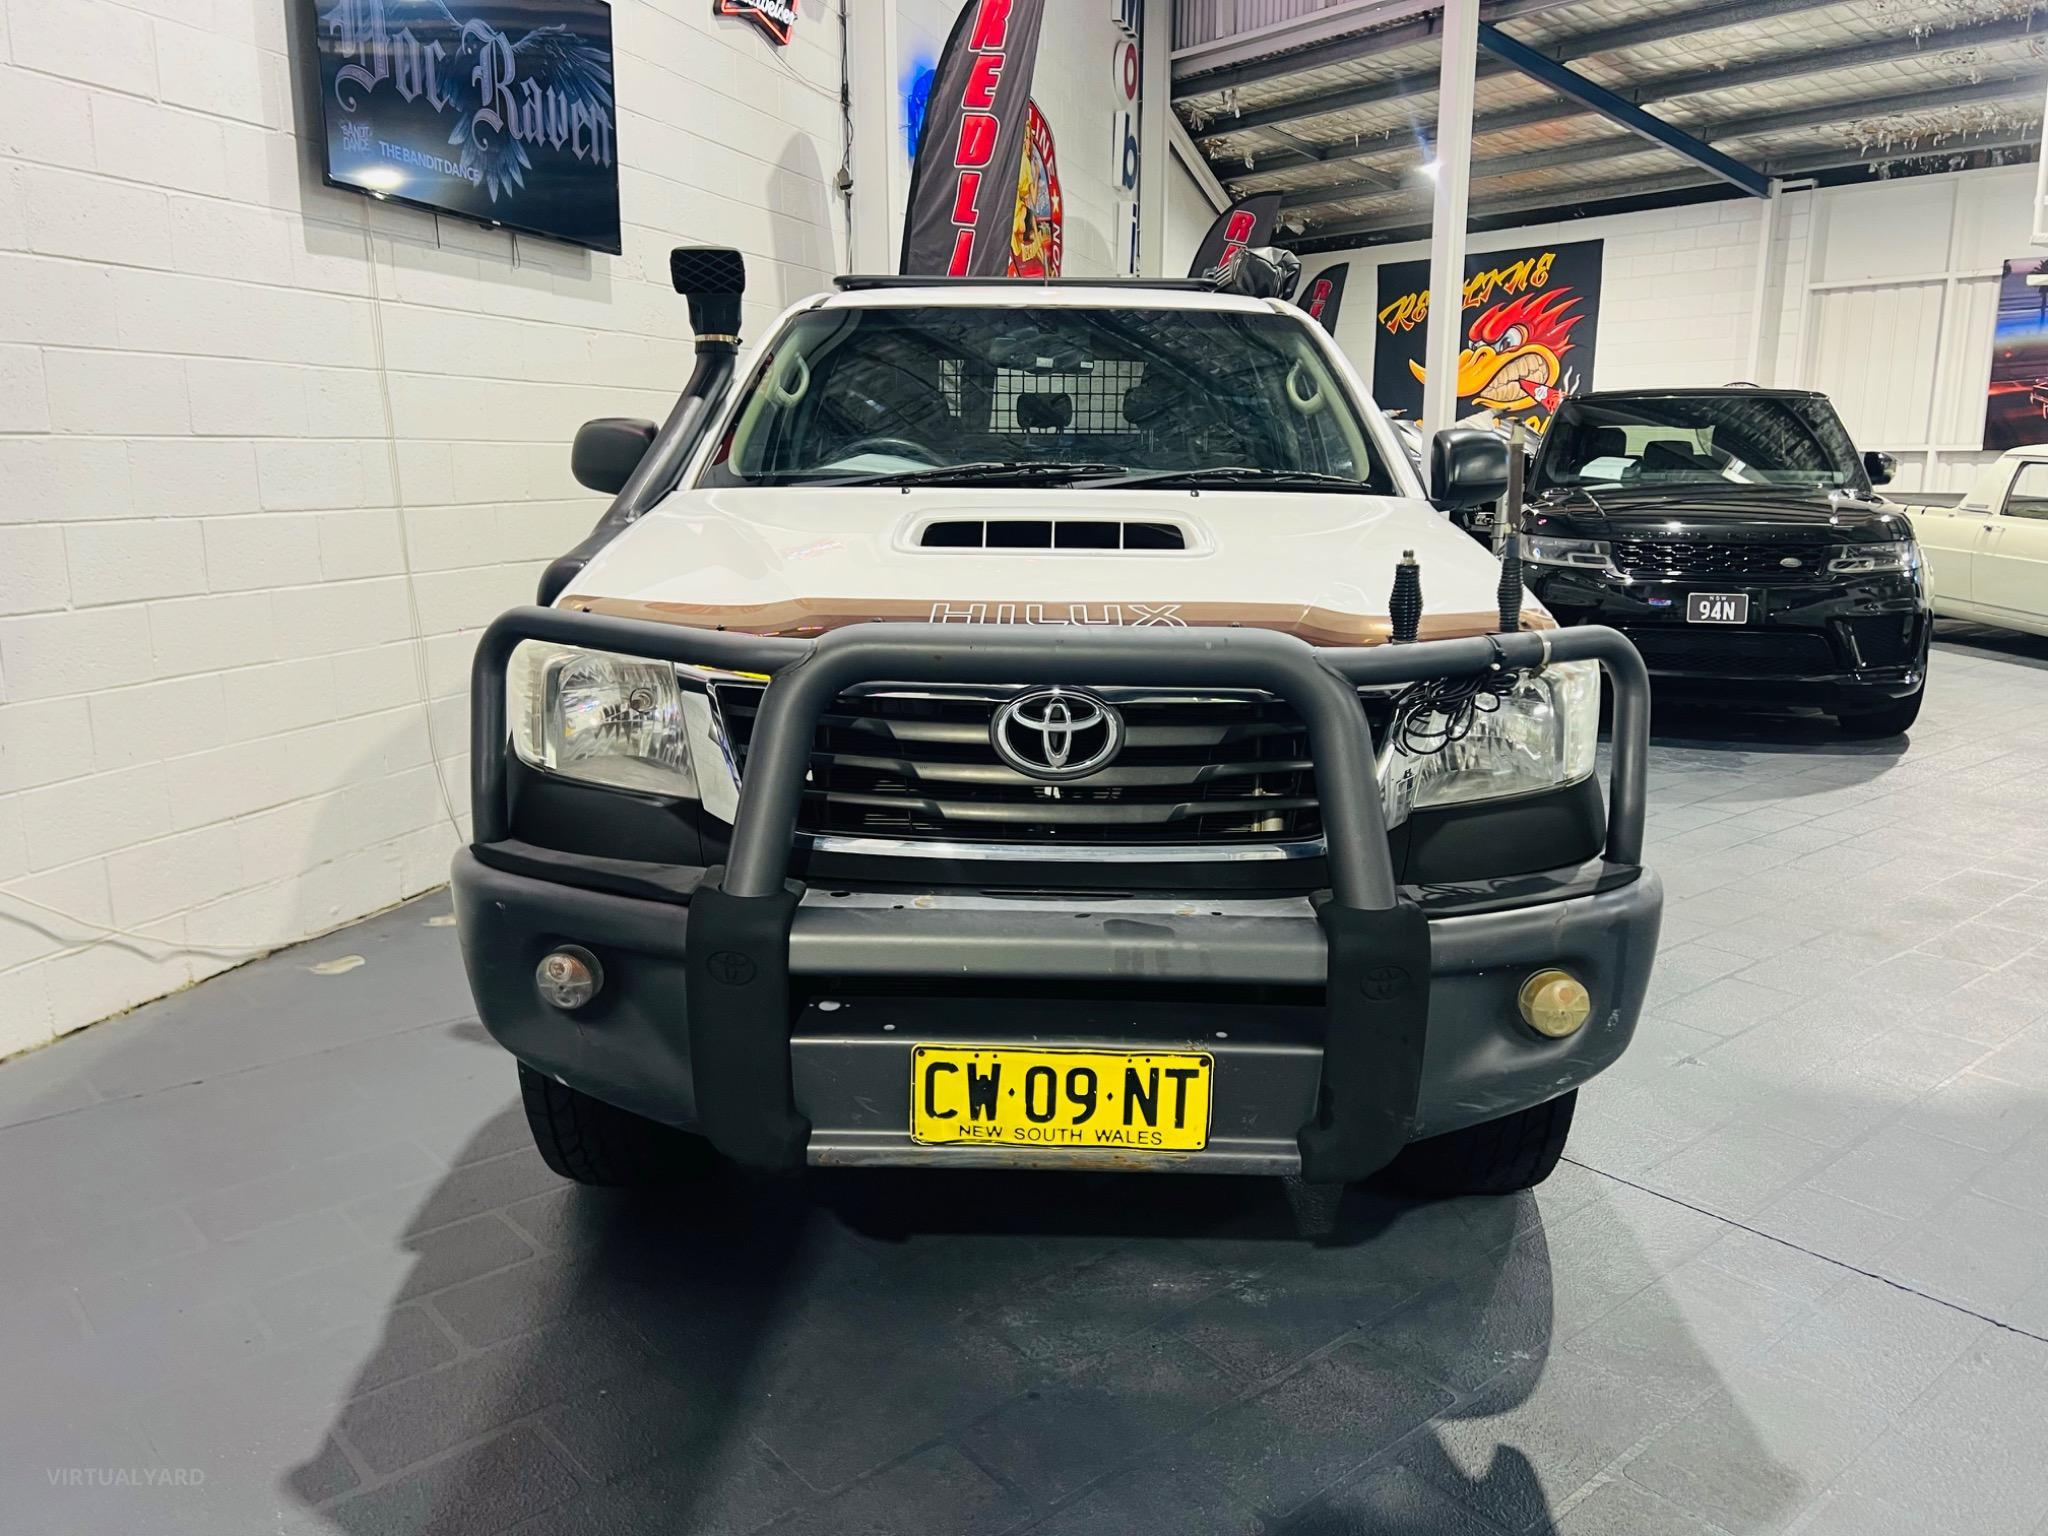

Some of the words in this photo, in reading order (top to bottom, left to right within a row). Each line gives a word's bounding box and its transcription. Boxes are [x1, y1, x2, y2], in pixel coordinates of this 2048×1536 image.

[461, 18, 613, 168] Raven
[379, 140, 402, 159] THE
[402, 147, 443, 172] BANDIT
[444, 161, 480, 181] DANCE
[1378, 253, 1556, 335] RELINE
[928, 602, 1188, 627] HILUX
[1700, 601, 1735, 620] 94N
[958, 1124, 1004, 1139] NEW
[1014, 1127, 1082, 1143] SOUTH
[1095, 1129, 1163, 1146] WALES
